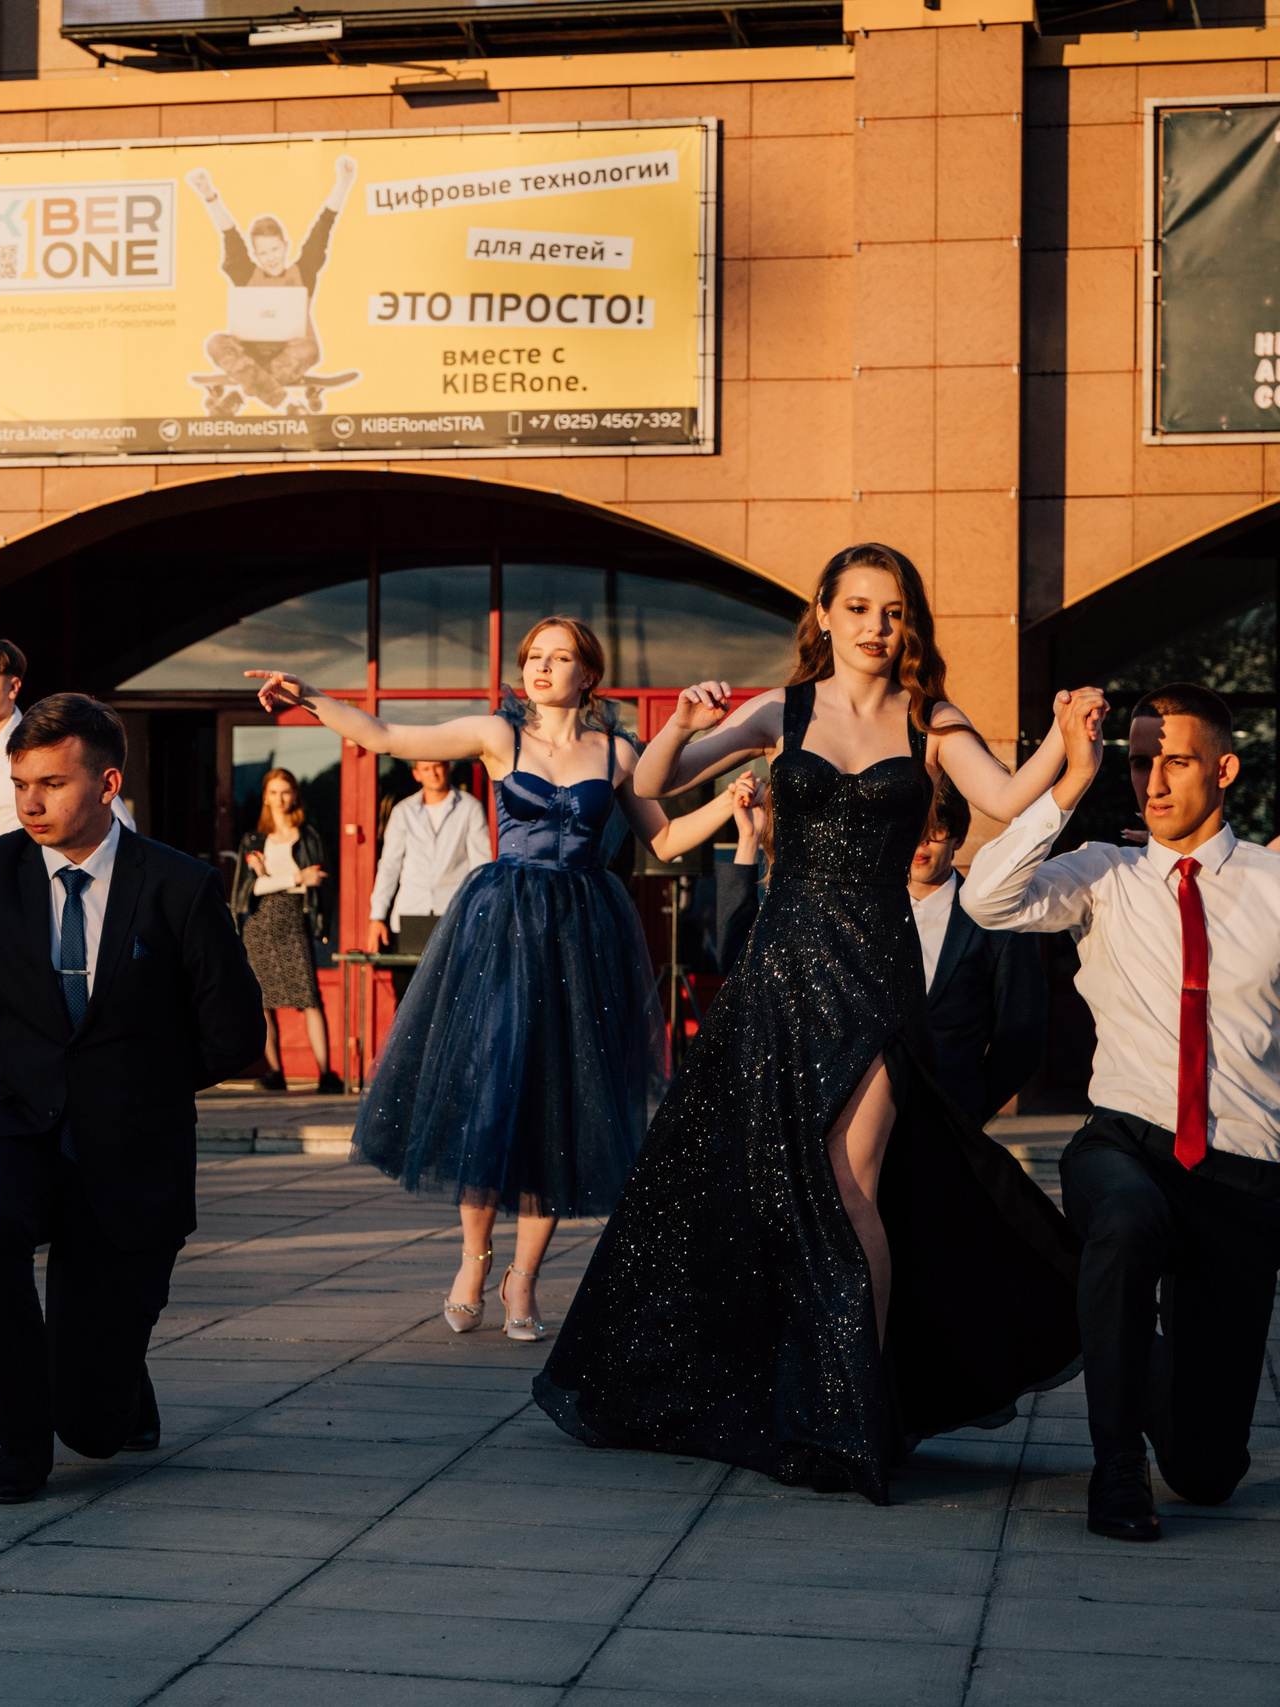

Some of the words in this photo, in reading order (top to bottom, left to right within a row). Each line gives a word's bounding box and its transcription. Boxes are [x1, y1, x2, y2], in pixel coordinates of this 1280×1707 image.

[375, 178, 512, 209] Цифровые
[520, 161, 670, 192] технологии
[42, 239, 158, 279] ONE
[474, 239, 522, 258] для
[530, 240, 604, 261] детей
[376, 291, 452, 321] ЭТО
[469, 292, 645, 325] ПРОСТО!
[443, 348, 541, 366] вместе
[552, 347, 565, 363] с
[1254, 358, 1280, 383] А
[443, 373, 587, 395] KIBERone.
[187, 419, 309, 437] KIBERoneISTRA
[361, 415, 485, 434] KIBERoneISTRA
[528, 414, 551, 430] +7
[554, 413, 598, 431] (925)
[600, 411, 682, 430] 4567-392
